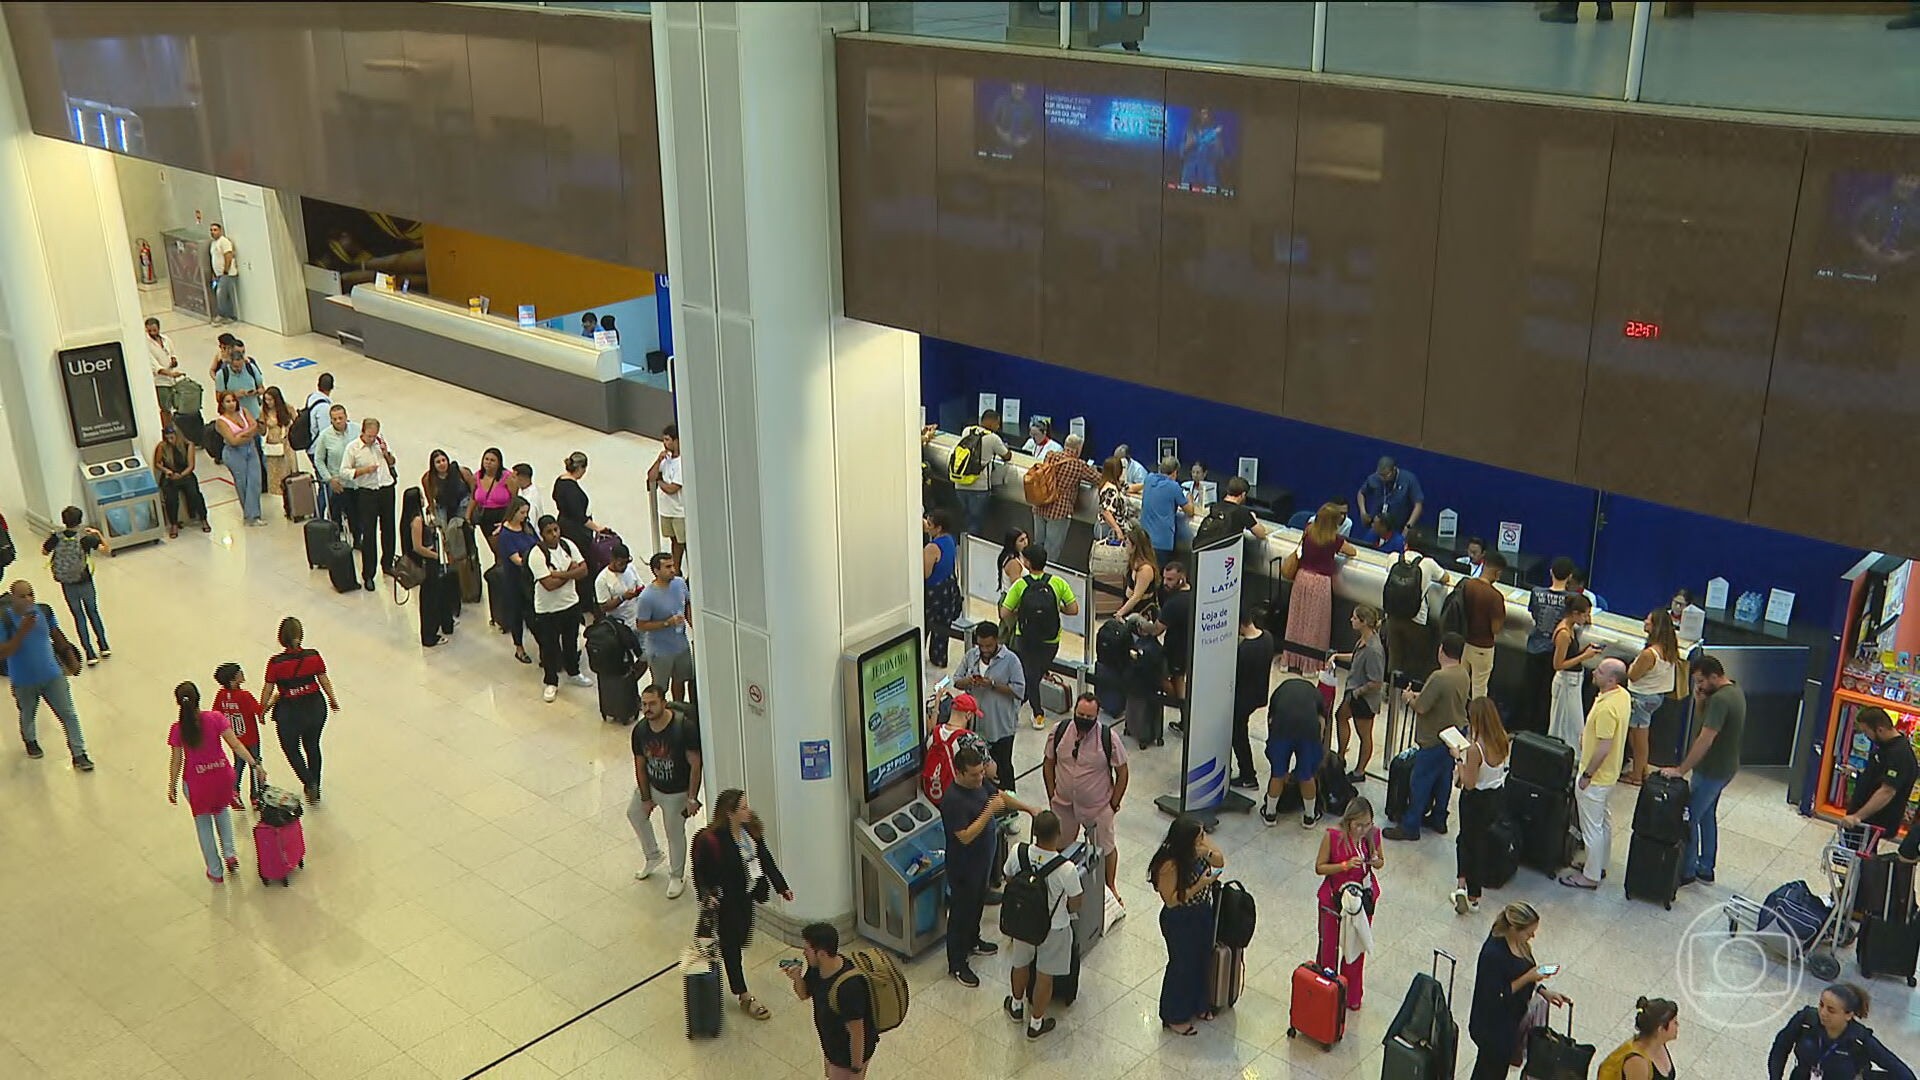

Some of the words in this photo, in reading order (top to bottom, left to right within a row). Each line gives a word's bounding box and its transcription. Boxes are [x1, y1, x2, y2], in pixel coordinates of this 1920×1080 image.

[67, 358, 113, 375] Uber
[1201, 611, 1218, 622] Loja
[1219, 608, 1228, 618] de
[1201, 620, 1228, 632] Vendas
